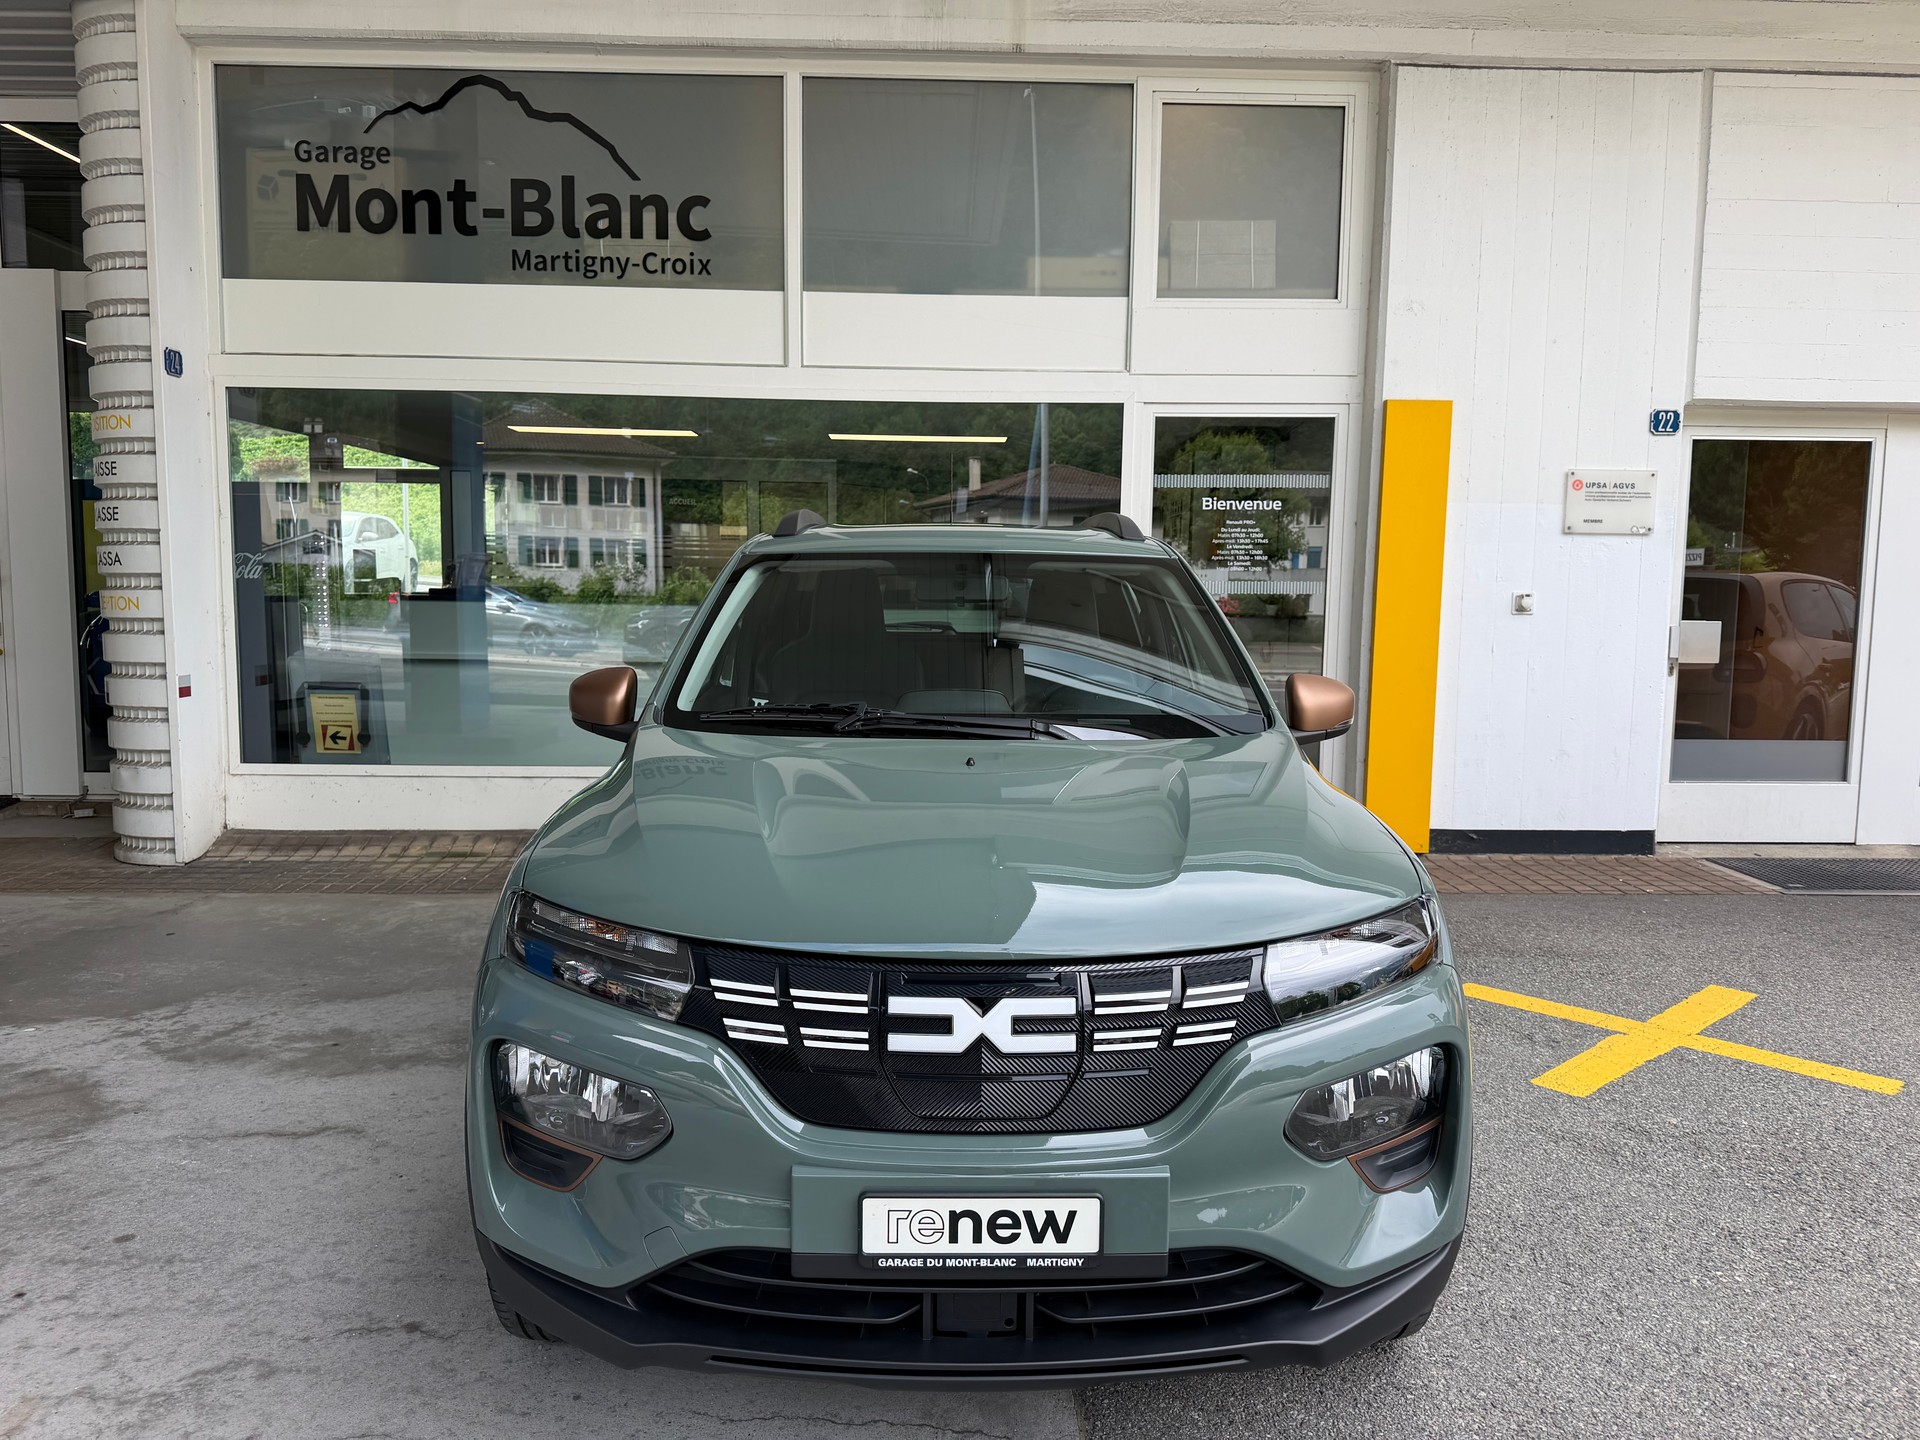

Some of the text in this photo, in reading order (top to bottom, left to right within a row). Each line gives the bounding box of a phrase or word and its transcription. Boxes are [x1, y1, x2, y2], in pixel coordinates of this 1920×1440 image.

[293, 139, 391, 170] Garage
[295, 173, 712, 242] Mont-Blanc
[511, 248, 712, 279] Martigny-Croix
[1658, 411, 1675, 432] 22
[95, 506, 119, 521] ASSE
[1202, 497, 1282, 510] Bienvenue
[98, 551, 122, 566] ASSA
[887, 1209, 1078, 1245] renew
[877, 1258, 1084, 1267] GARAGE DU MONT-BLANC MARTIGNY
